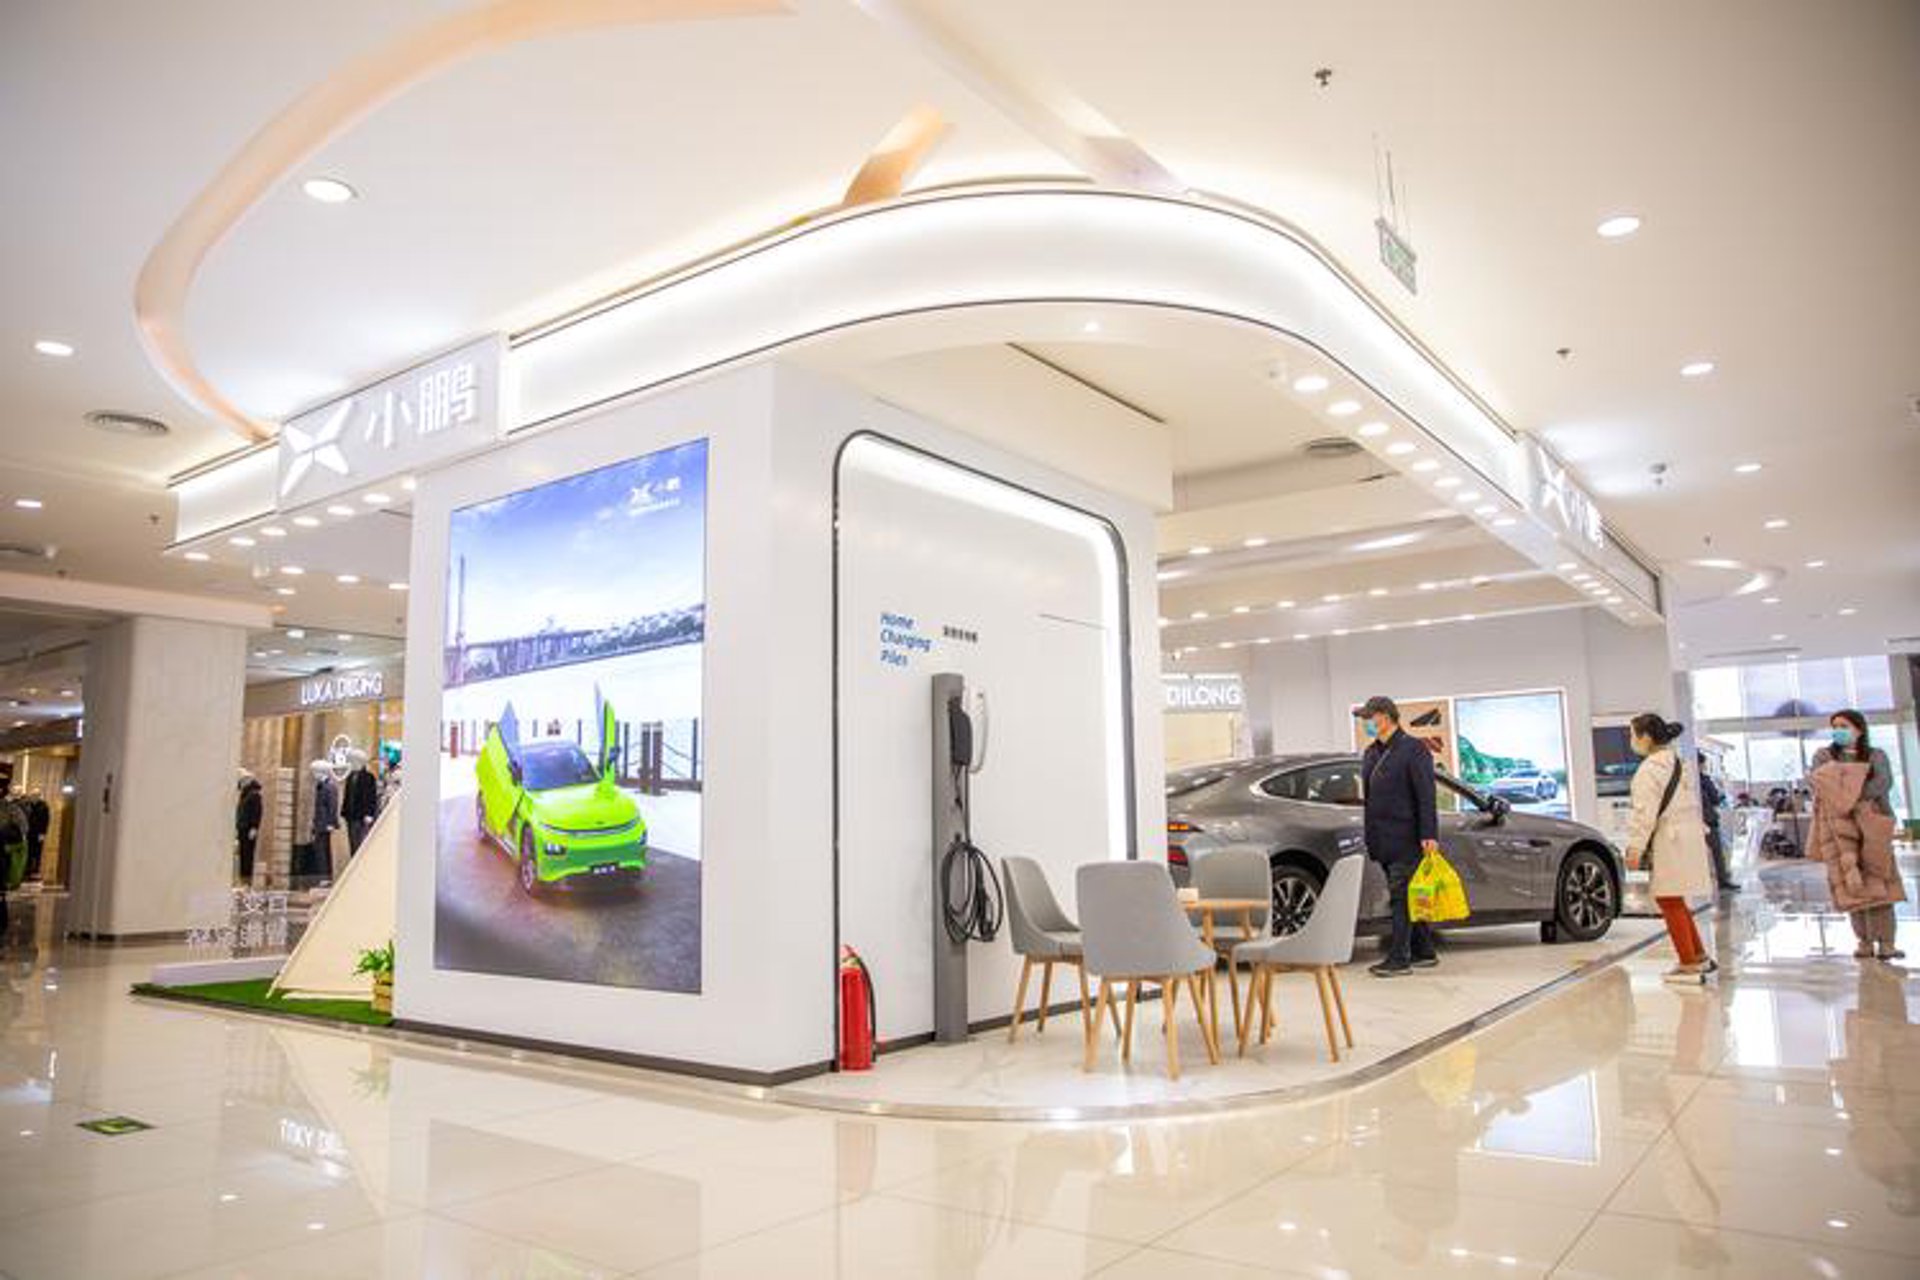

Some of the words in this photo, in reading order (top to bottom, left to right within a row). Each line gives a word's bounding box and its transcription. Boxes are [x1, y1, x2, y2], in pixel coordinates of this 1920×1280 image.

[365, 363, 473, 449] 小鹏
[881, 612, 914, 629] Home
[881, 629, 931, 653] Charging
[1167, 685, 1242, 706] DILONG
